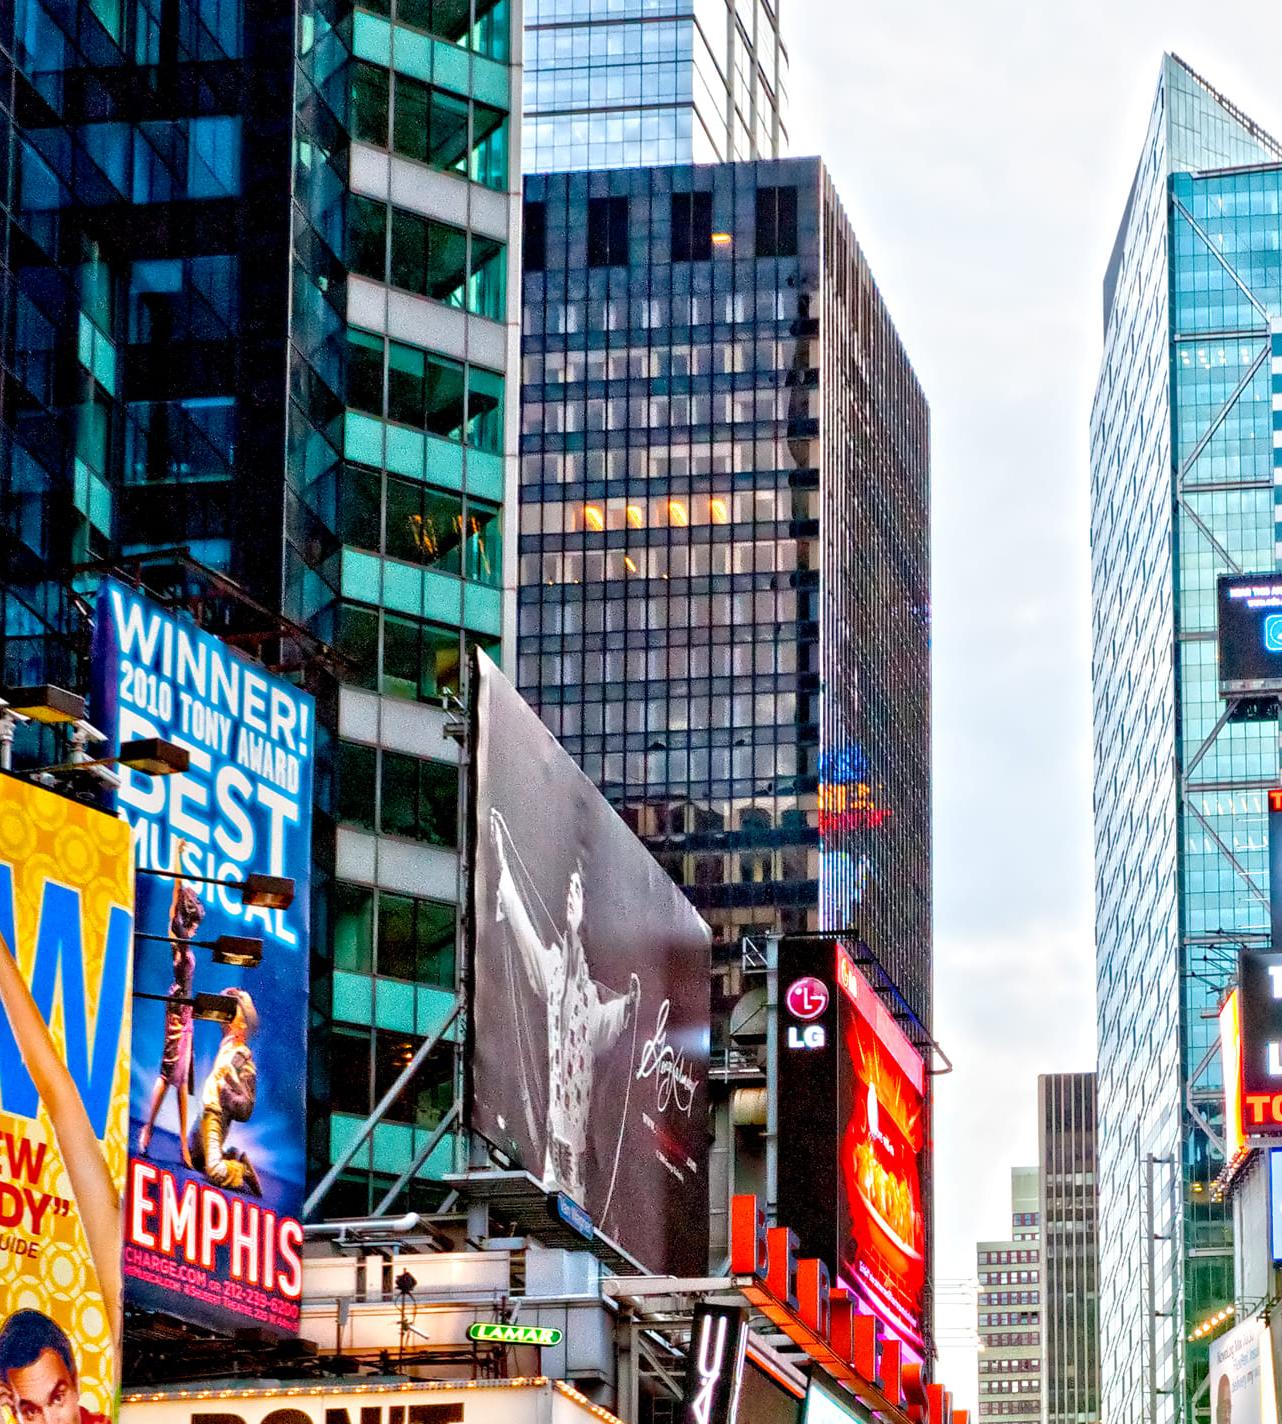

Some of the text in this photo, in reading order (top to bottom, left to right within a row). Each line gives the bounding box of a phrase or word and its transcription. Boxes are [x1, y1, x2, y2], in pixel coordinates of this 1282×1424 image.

[111, 590, 310, 758] WINNER!
[119, 659, 301, 795] 2010 TONY AWARD
[117, 705, 300, 880] BEST
[787, 1025, 826, 1049] LG
[0, 1130, 47, 1185] W
[476, 1323, 555, 1344] LAMAR
